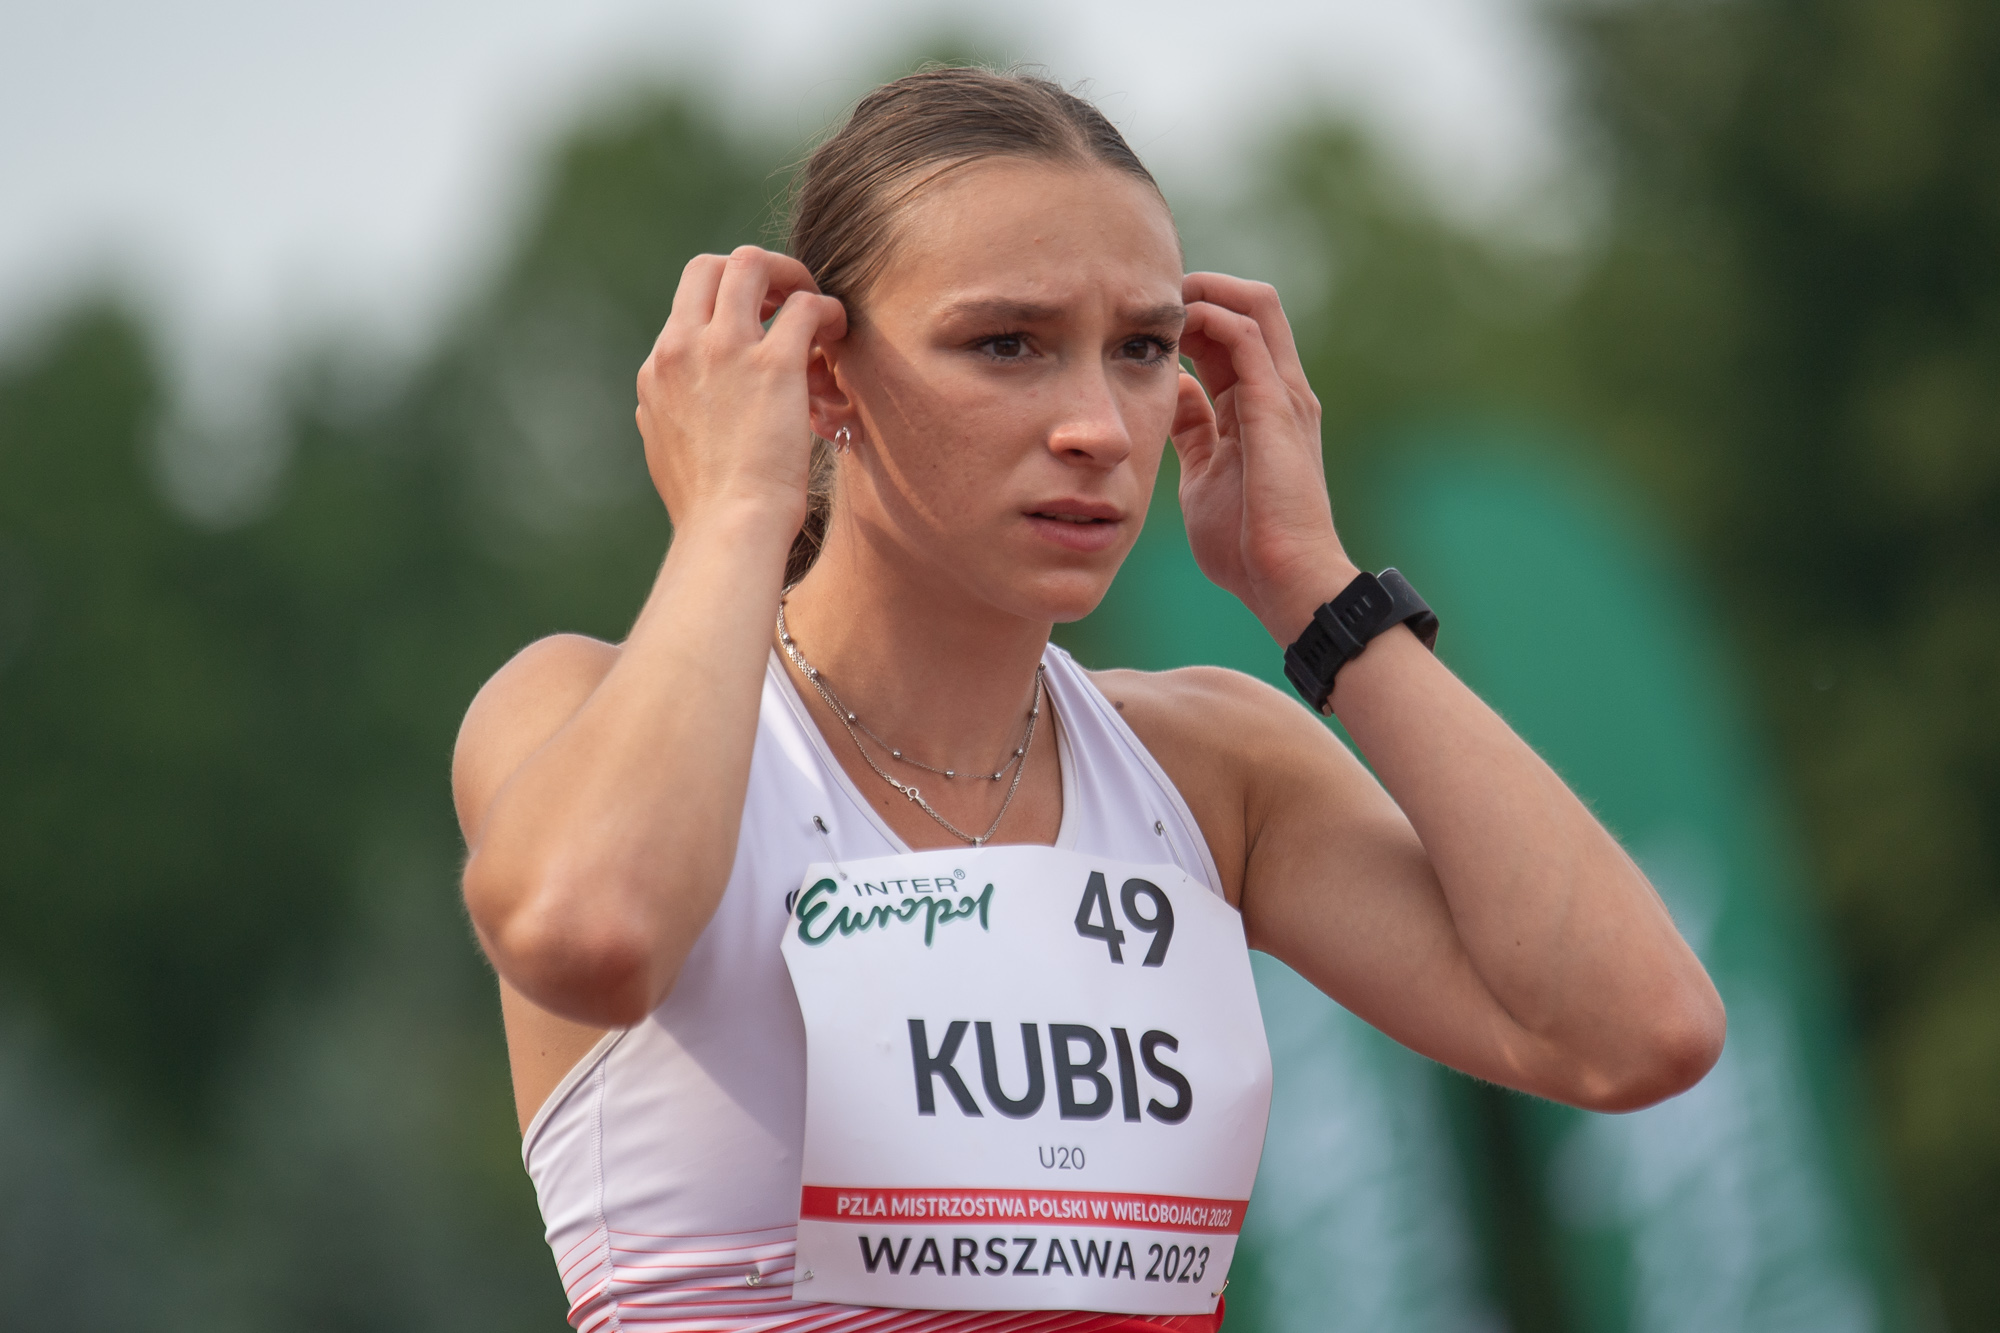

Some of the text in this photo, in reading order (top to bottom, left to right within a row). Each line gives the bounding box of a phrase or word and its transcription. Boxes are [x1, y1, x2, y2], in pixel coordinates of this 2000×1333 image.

[796, 878, 995, 949] Europol
[1074, 871, 1175, 967] 49
[907, 1019, 1194, 1126] KUBIS
[1038, 1146, 1086, 1171] U20
[837, 1197, 1232, 1228] PZLA MISTRZOSTWA POLSKI W WIELOBOJACH 2023
[858, 1236, 1211, 1284] WARSZAWA 2023
